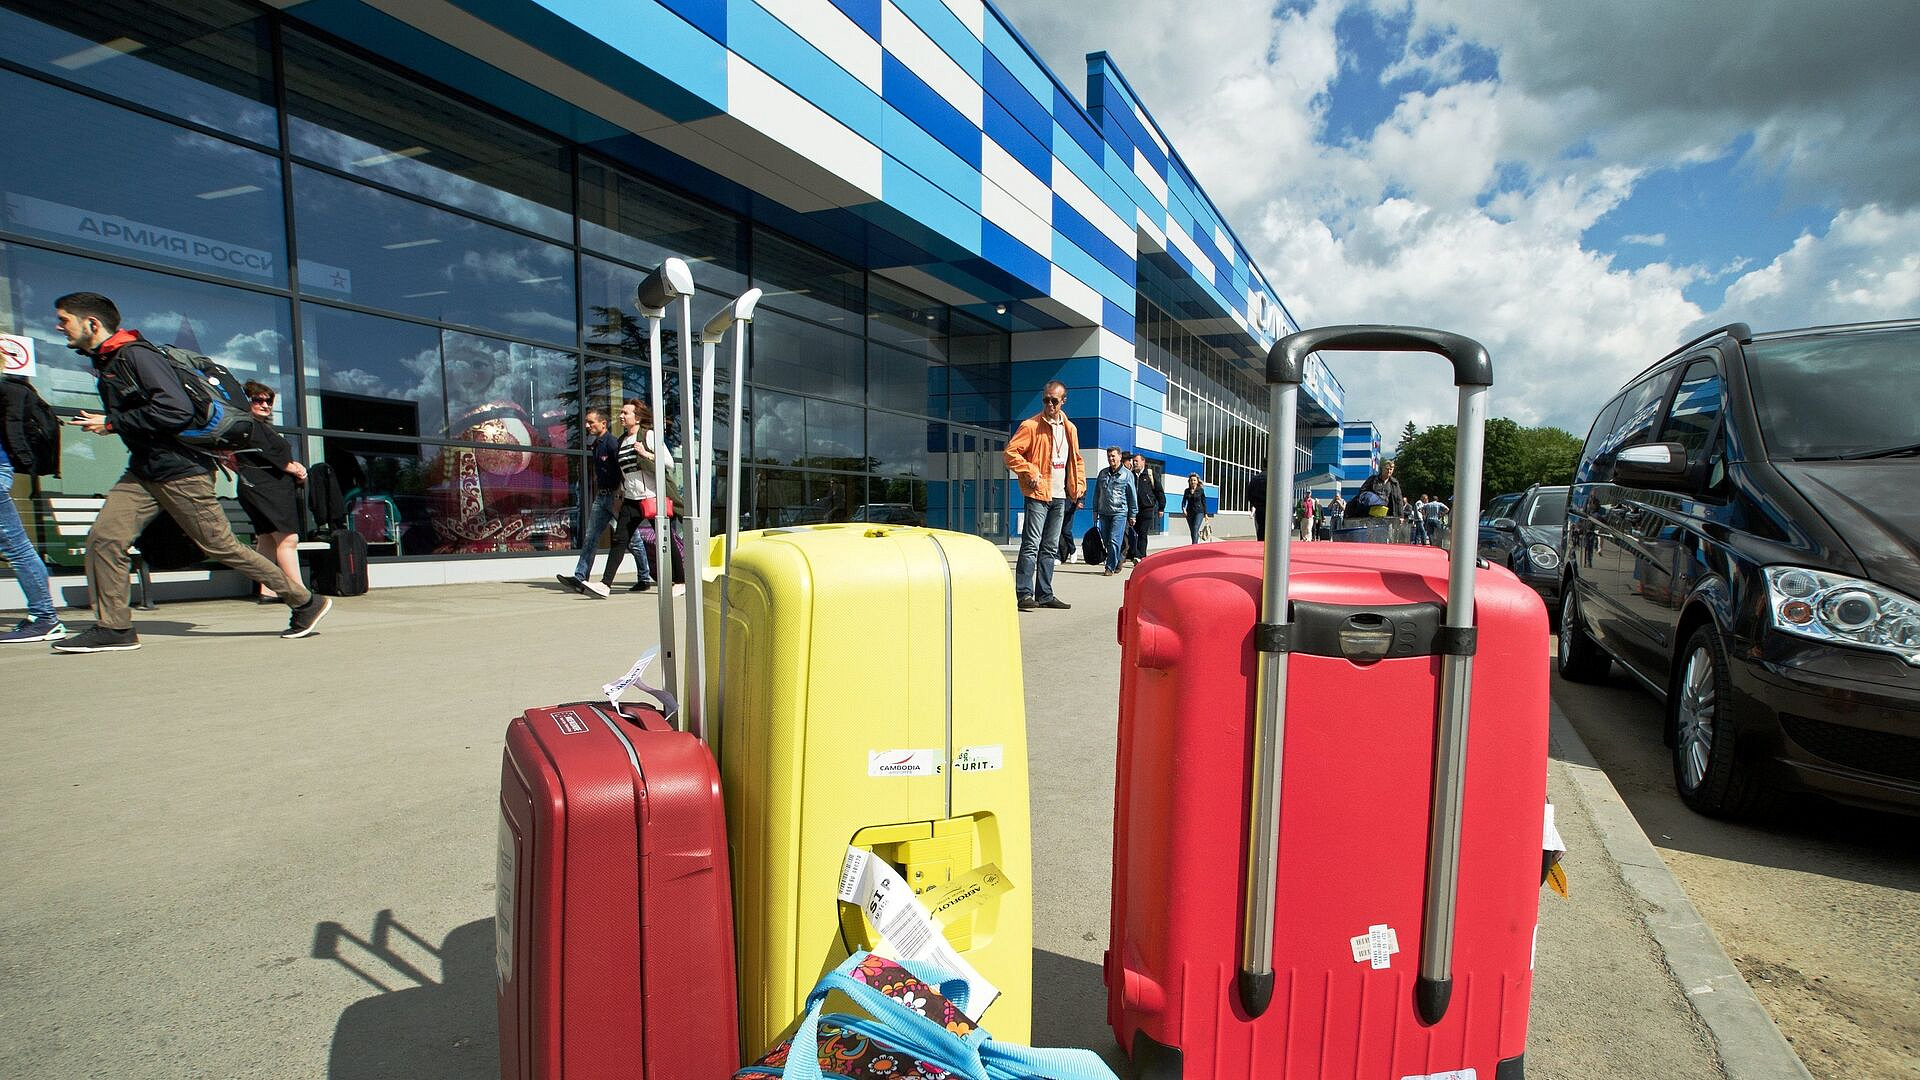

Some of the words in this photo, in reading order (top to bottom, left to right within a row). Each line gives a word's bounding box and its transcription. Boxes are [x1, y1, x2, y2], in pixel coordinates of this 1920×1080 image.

[78, 216, 188, 255] АРМИЯ
[193, 241, 273, 270] РОССИ
[938, 886, 981, 912] AEROFLOT
